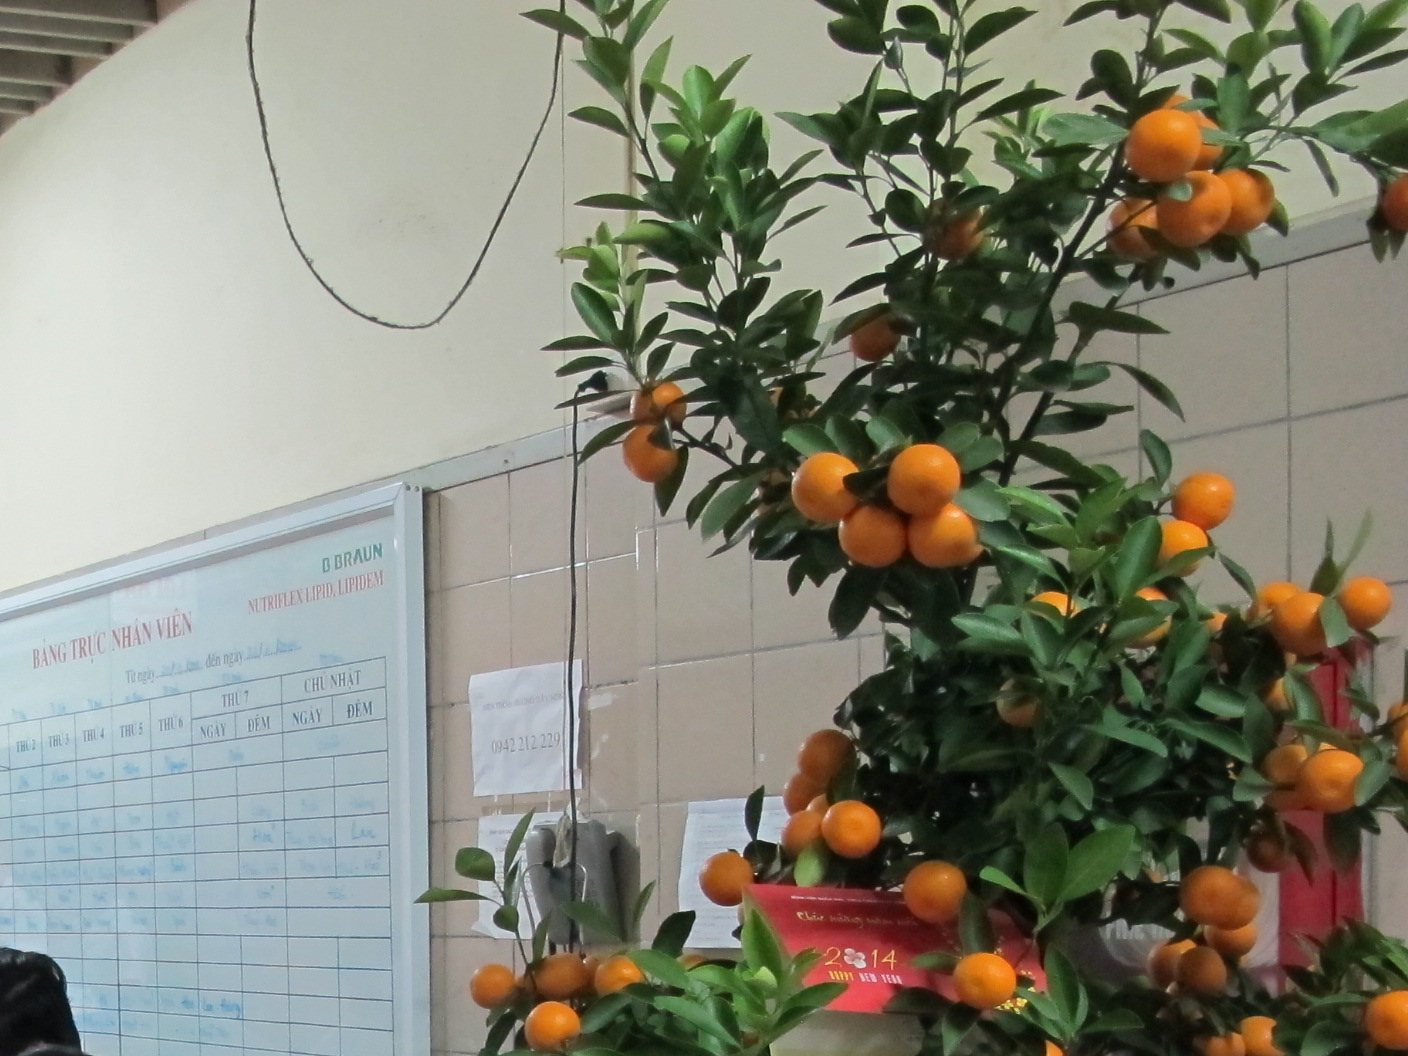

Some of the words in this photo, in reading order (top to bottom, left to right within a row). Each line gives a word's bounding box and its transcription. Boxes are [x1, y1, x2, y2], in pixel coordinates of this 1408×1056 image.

[334, 543, 383, 570] BRAUN
[248, 588, 303, 614] NUTRIFLEX
[338, 570, 384, 595] LIPIDEM
[32, 638, 67, 669] BẢNG
[70, 630, 107, 664] TRỰC
[111, 618, 152, 651] NHÂN
[155, 607, 192, 640] VIÊN
[205, 653, 221, 668] đến
[304, 671, 327, 693] CHỦ
[330, 669, 362, 691] NHẬT
[221, 688, 242, 708] THỨ
[244, 690, 249, 703] 7
[293, 704, 322, 725] NGÀY
[346, 699, 373, 719] ĐÊM
[200, 720, 227, 739] NGÀY
[247, 714, 271, 733] ĐÊM
[492, 738, 515, 754] 0942
[518, 735, 536, 751] 212
[541, 731, 560, 749] 229
